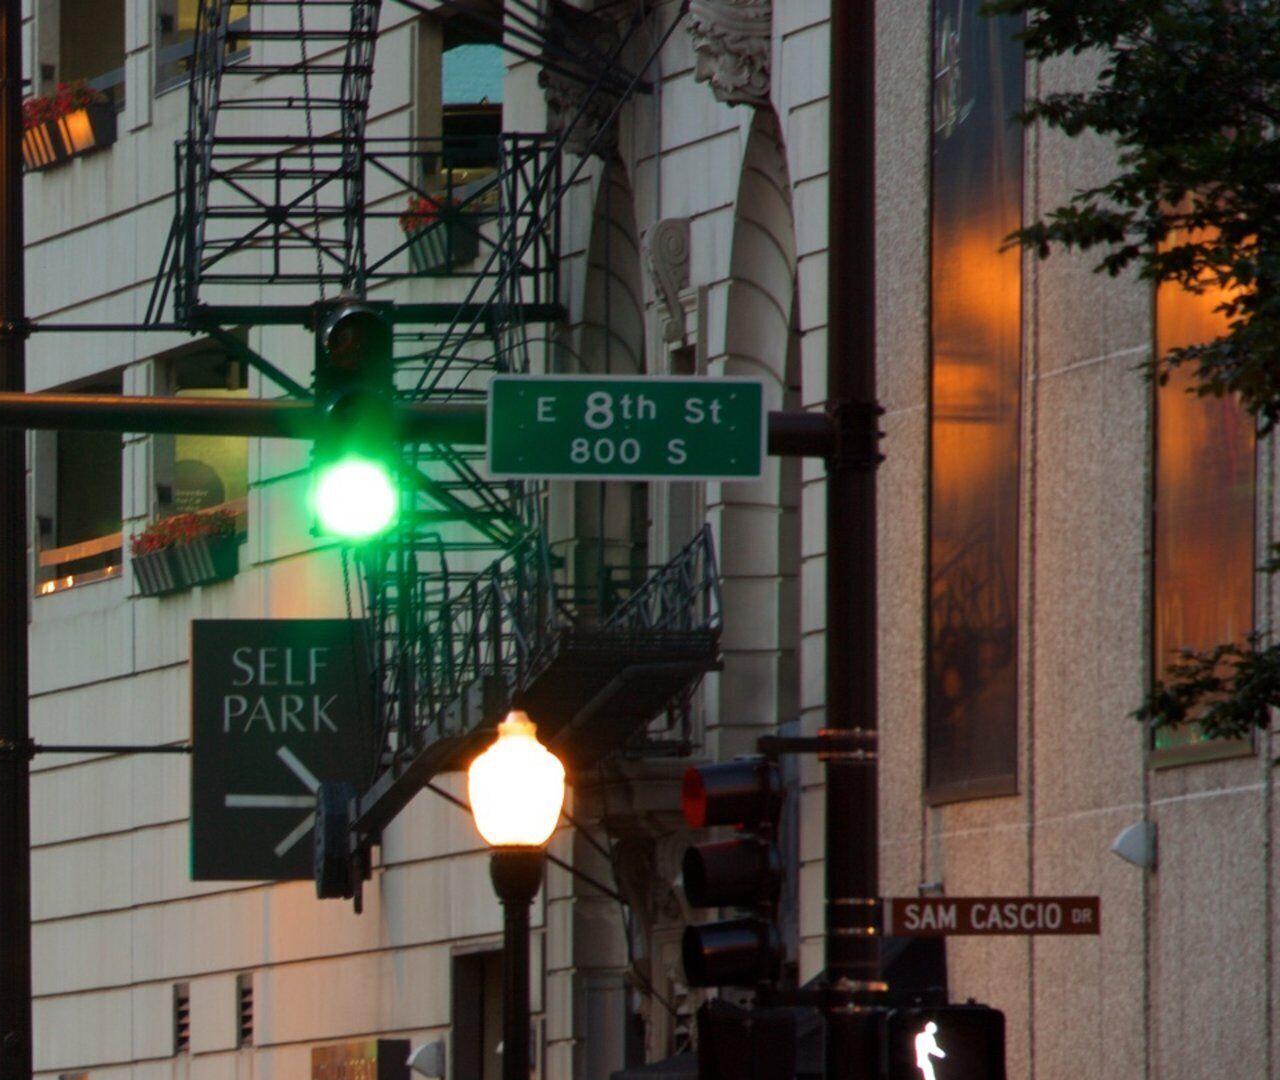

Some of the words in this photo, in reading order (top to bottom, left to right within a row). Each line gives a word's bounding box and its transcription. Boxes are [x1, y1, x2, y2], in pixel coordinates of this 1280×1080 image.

[537, 397, 556, 422] E
[584, 391, 656, 429] 8th
[685, 398, 722, 424] St
[570, 438, 640, 464] 800
[668, 439, 687, 464] S
[232, 647, 329, 686] SELF
[224, 694, 338, 733] PARK
[904, 904, 958, 930] SAM
[970, 904, 1063, 929] CASCIO
[1071, 908, 1093, 924] DR
